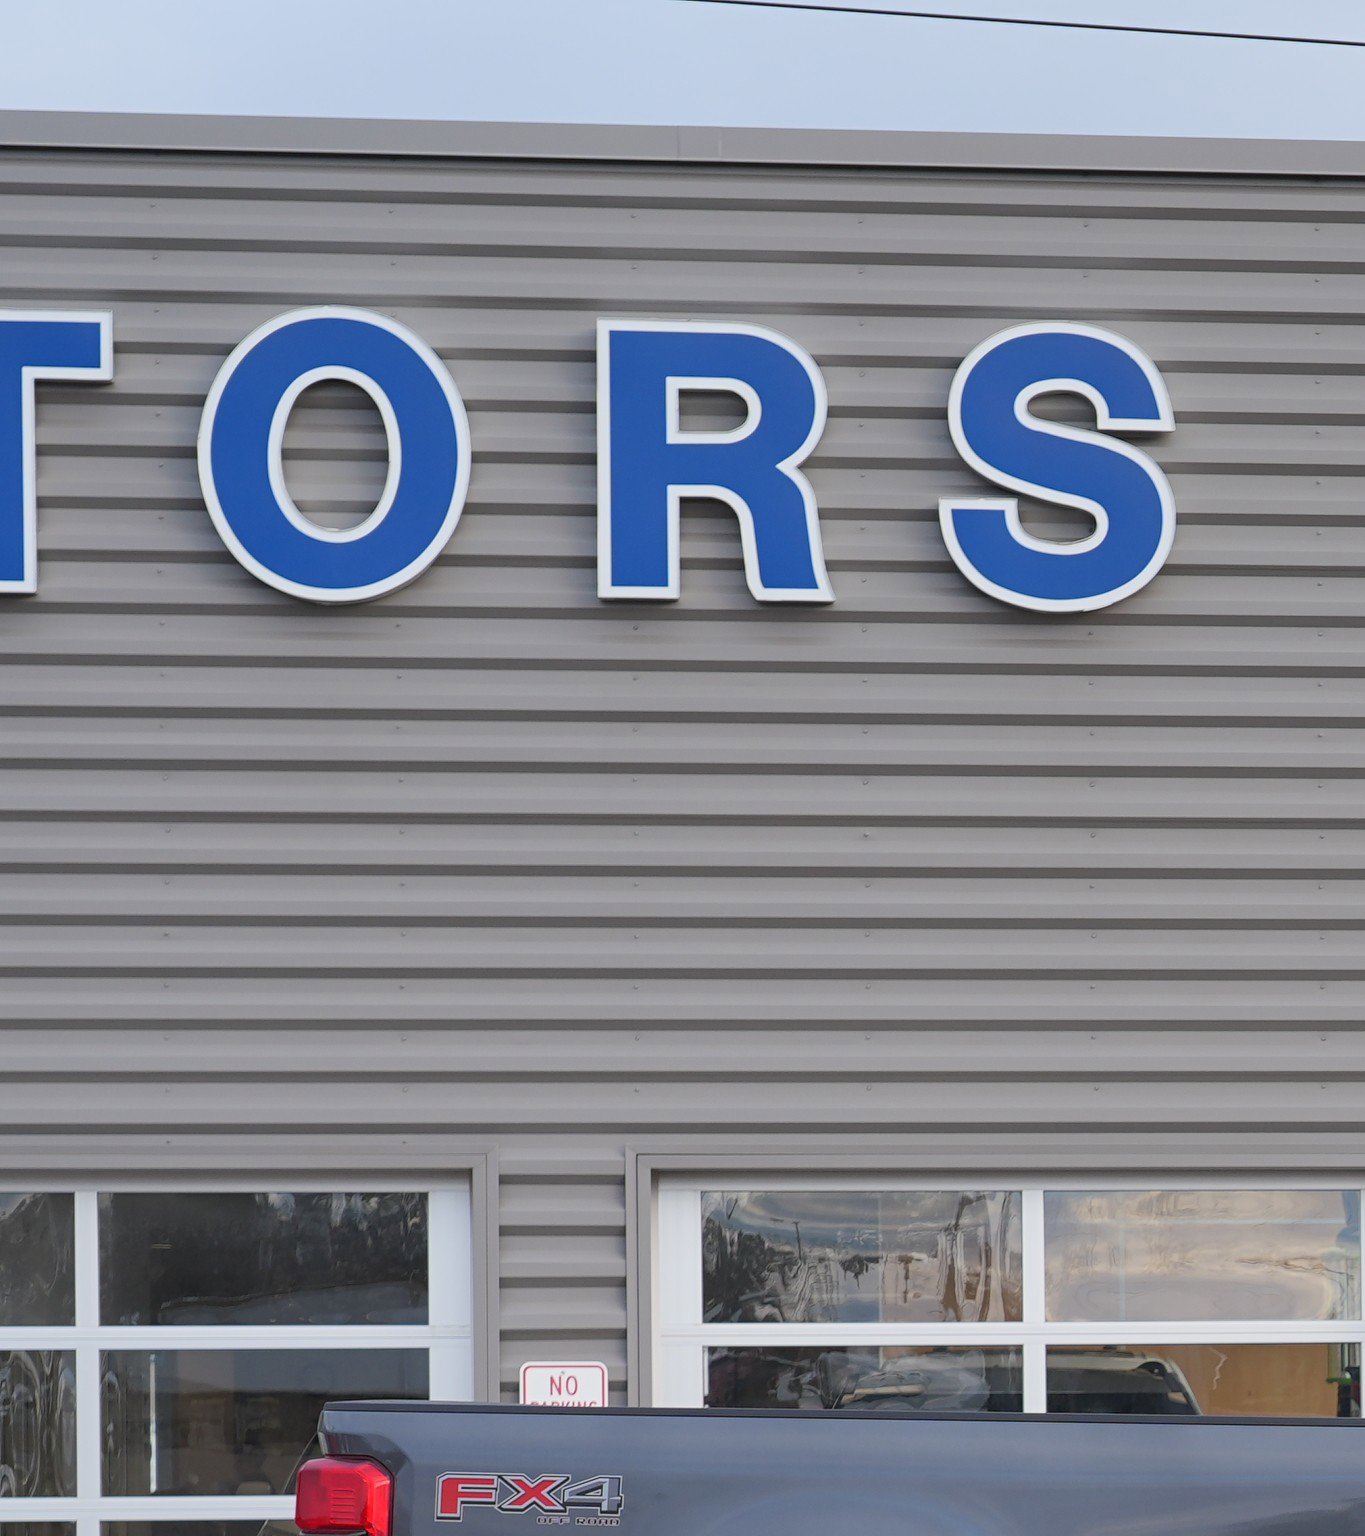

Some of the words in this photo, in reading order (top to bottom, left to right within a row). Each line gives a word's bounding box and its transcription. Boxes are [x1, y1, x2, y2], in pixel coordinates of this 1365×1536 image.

[550, 1375, 578, 1396] NO
[435, 1472, 624, 1522] FX4
[537, 1516, 570, 1525] OFF
[575, 1517, 620, 1526] ROAD
